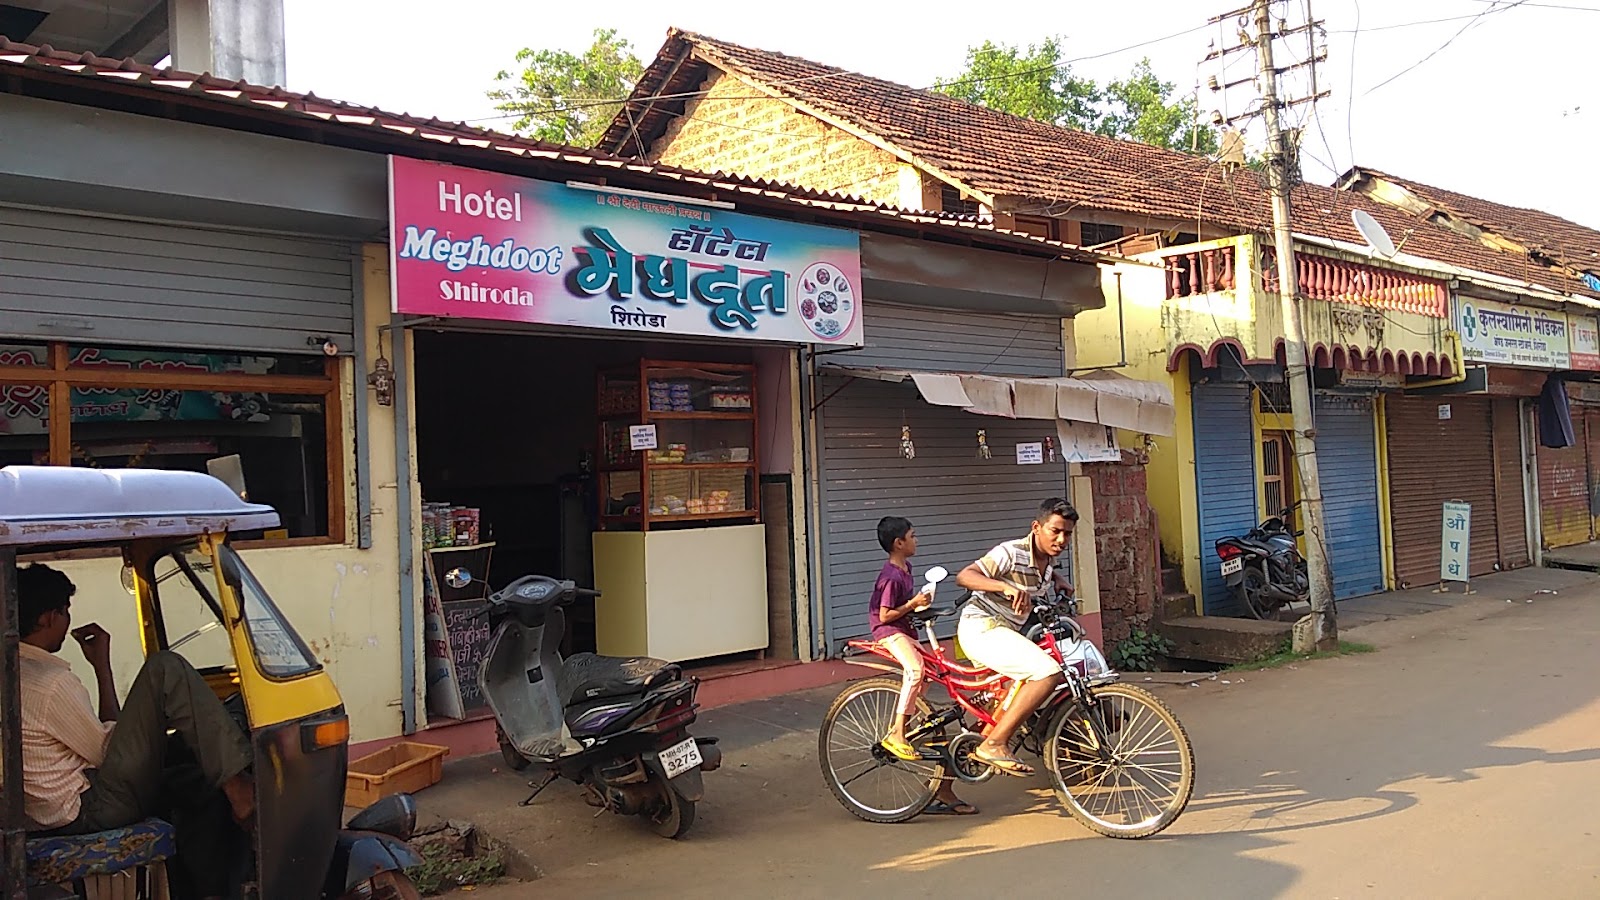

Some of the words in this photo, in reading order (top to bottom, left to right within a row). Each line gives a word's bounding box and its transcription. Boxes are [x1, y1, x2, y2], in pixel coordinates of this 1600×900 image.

[438, 180, 522, 222] Hotel
[607, 195, 620, 207] श्री
[622, 197, 640, 211] देवी
[400, 225, 563, 274] Meghdoot
[667, 224, 772, 262] हॉटेल
[570, 226, 791, 328] मेघदूत
[440, 279, 534, 307] Shiroda
[610, 305, 667, 327] शिरोडा
[1478, 307, 1532, 337] कुलस्वामिनी
[1534, 310, 1565, 338] मेडिकल
[666, 742, 691, 758] MH-07-R
[667, 750, 697, 771] 3275
